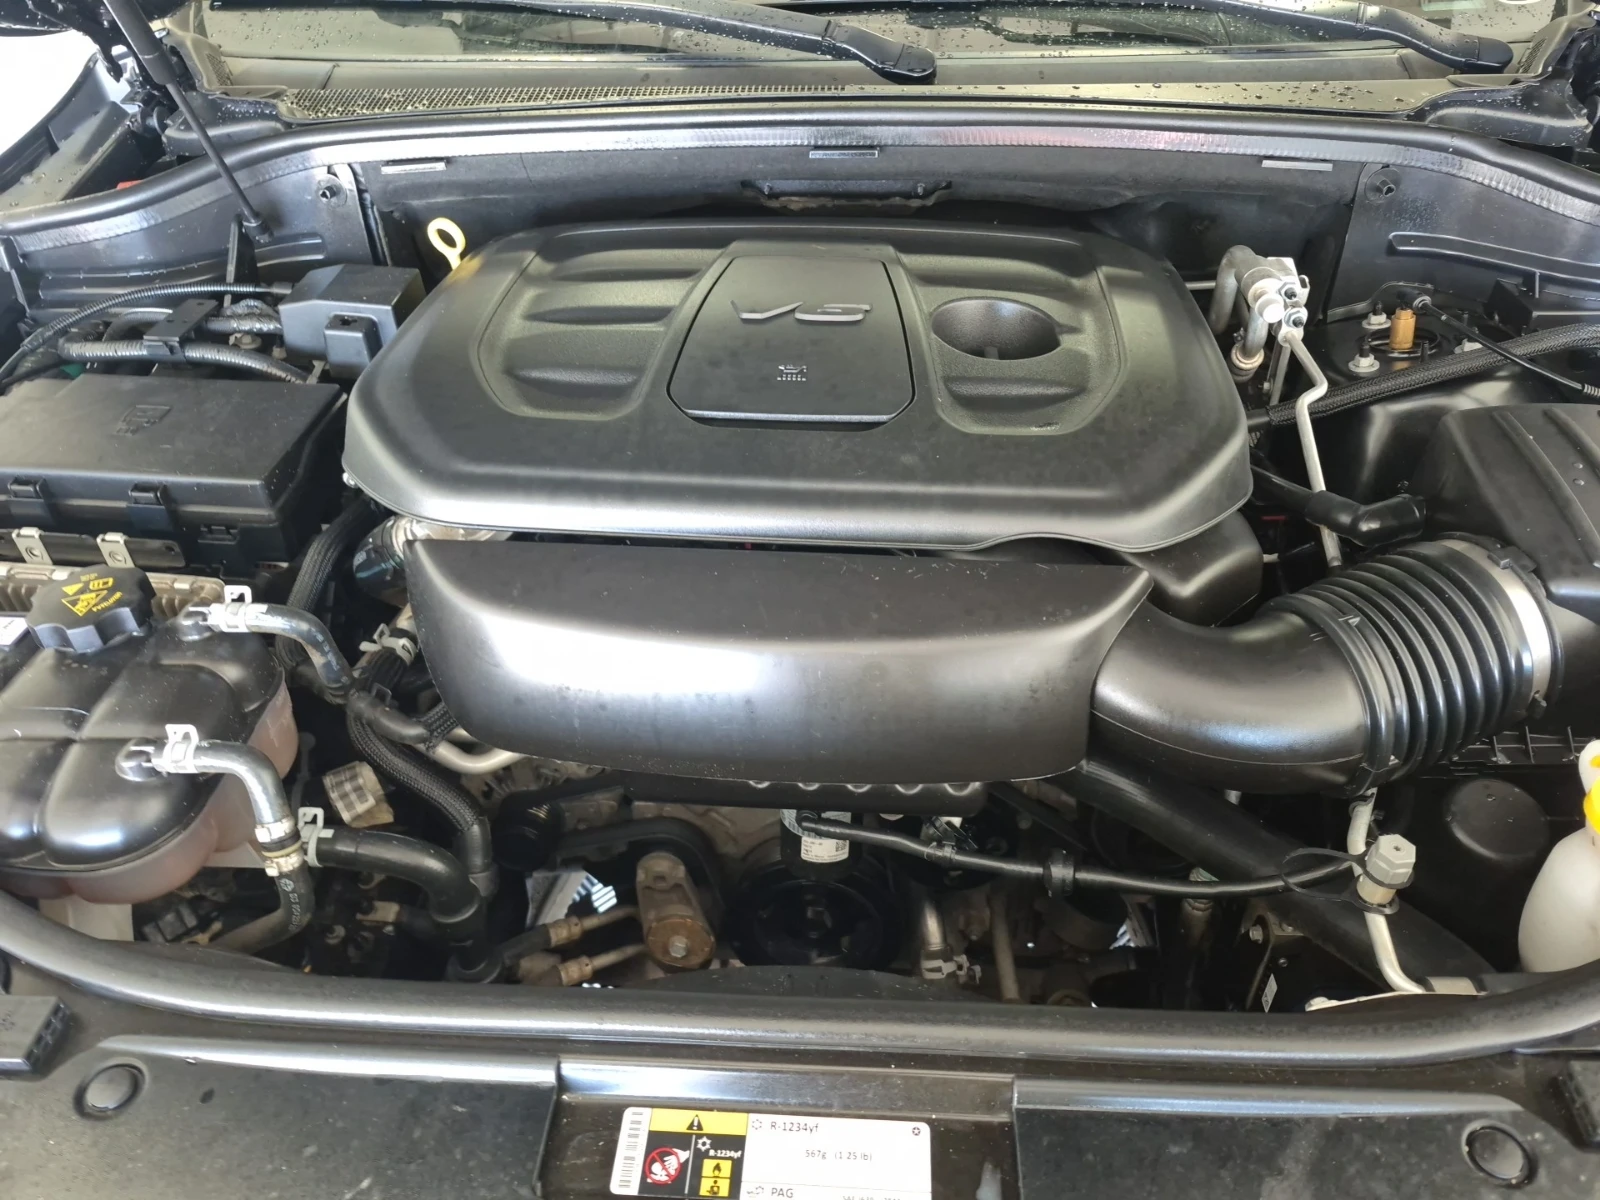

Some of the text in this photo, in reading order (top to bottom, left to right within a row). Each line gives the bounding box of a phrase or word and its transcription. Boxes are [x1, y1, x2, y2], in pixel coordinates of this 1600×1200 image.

[730, 300, 873, 322] V6
[770, 1121, 820, 1135] R-1234yf
[708, 1149, 742, 1160] R-1234yf
[805, 1149, 827, 1160] 567g
[771, 1187, 795, 1199] PAG
